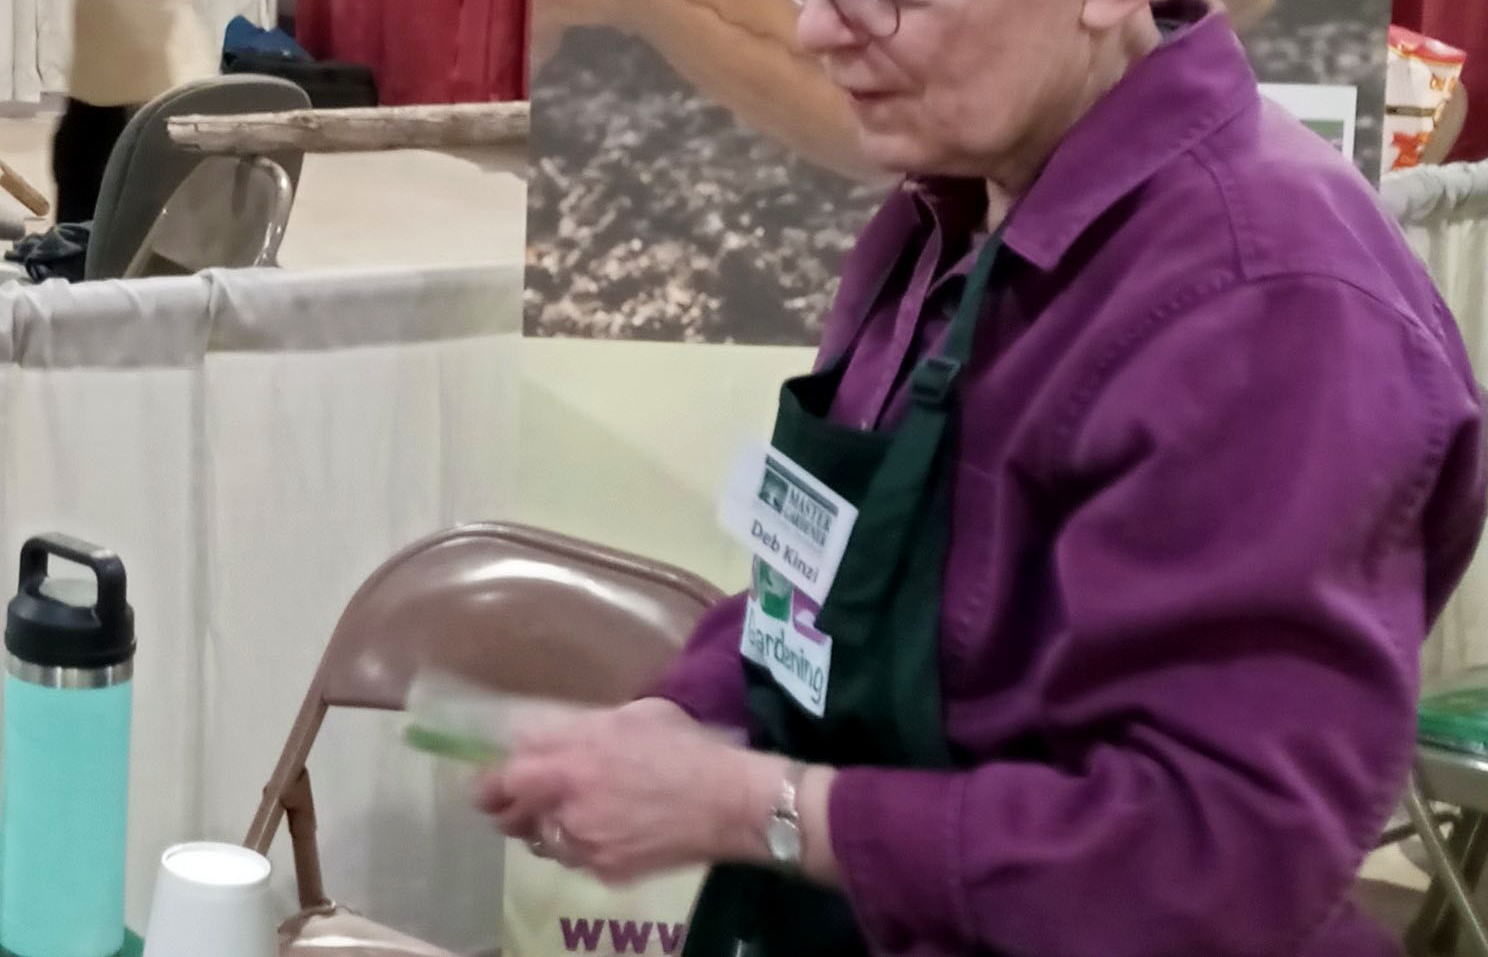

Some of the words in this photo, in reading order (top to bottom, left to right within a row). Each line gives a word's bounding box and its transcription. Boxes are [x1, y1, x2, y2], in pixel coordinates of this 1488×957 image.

[788, 486, 832, 533] MASTER
[751, 518, 780, 552] Deb
[782, 543, 820, 584] Kinzi
